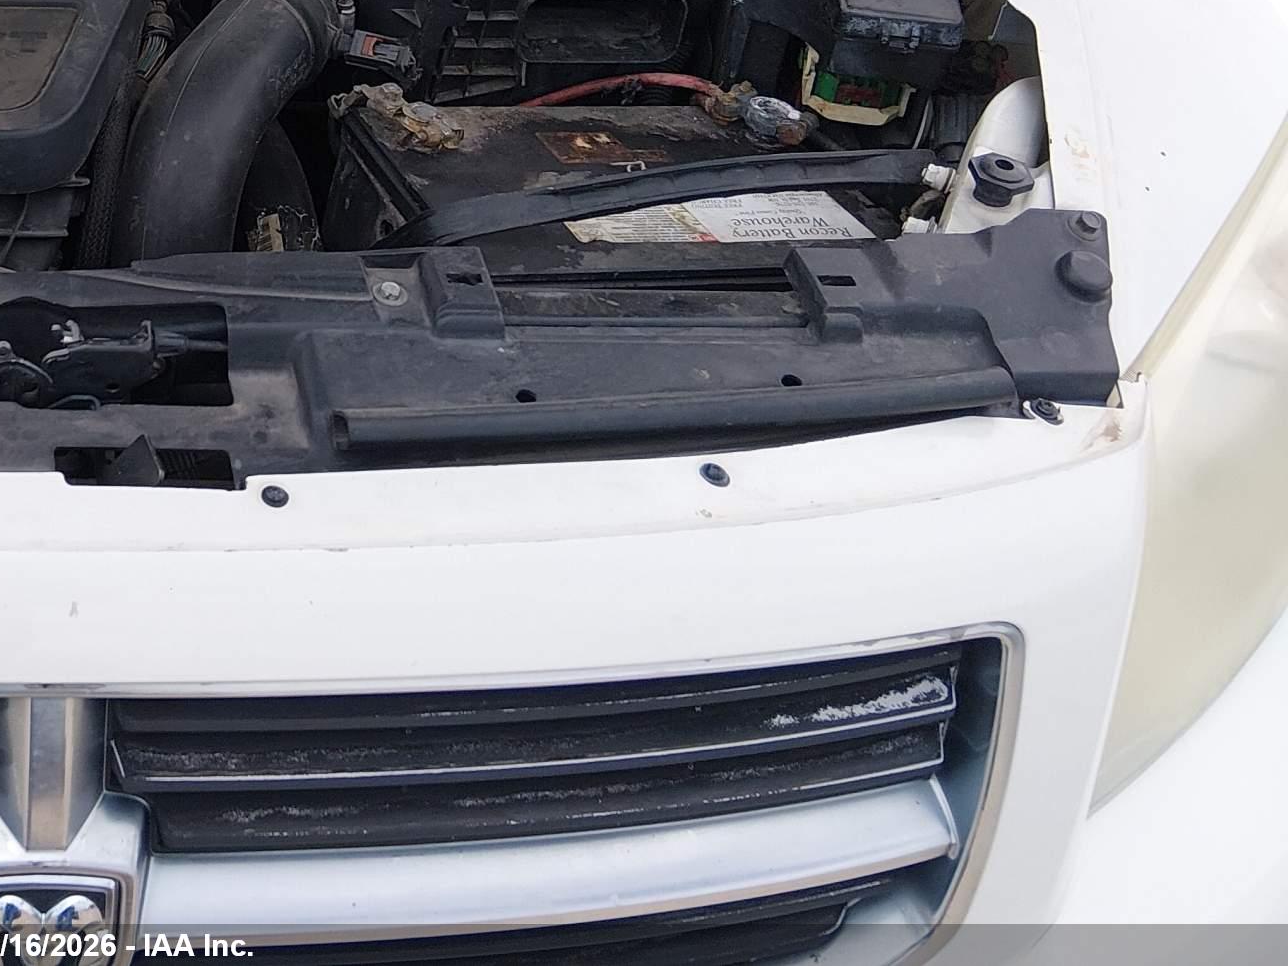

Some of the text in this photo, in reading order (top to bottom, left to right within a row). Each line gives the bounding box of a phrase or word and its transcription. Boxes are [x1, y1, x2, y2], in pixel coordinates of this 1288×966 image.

[730, 216, 830, 228] Warehouse
[732, 227, 852, 239] Recon Battery
